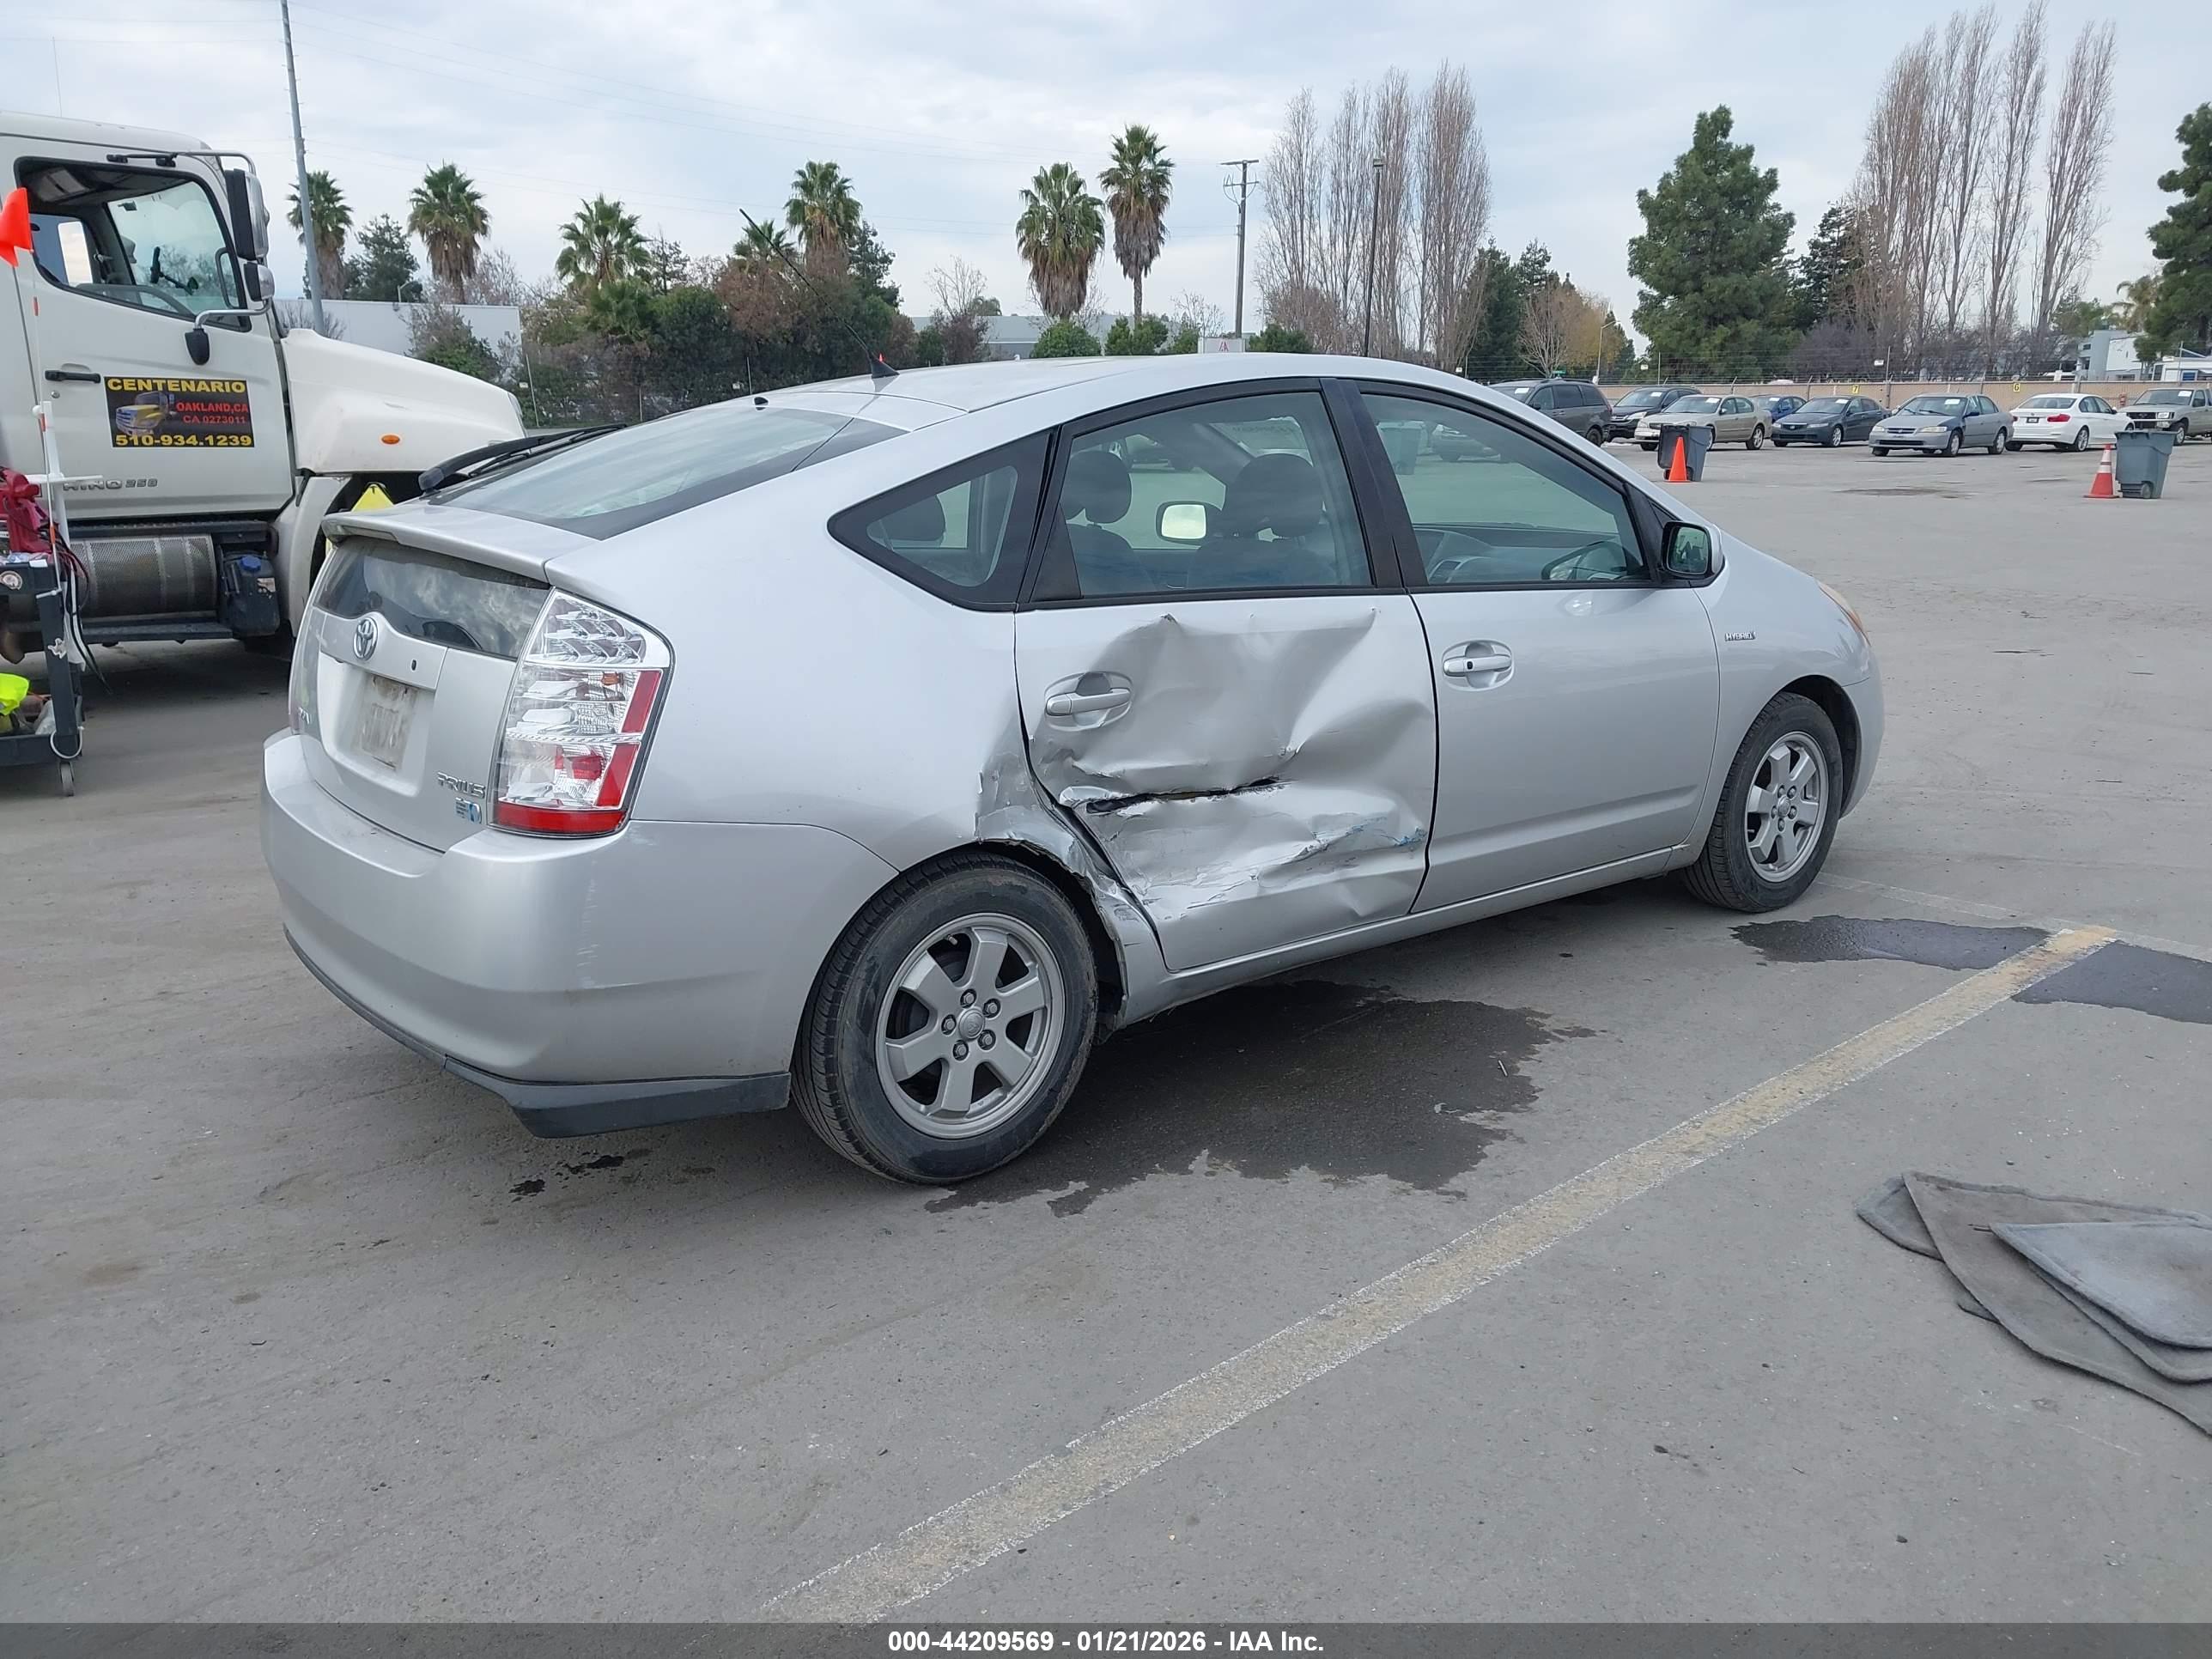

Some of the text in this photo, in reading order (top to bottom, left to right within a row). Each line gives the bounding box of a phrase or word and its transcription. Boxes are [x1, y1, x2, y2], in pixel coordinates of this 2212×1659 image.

[107, 379, 246, 393] CENTENARIO
[176, 402, 248, 413] OAKLAND,CA
[183, 415, 199, 424] CA
[115, 434, 252, 447] 510-934.1239
[437, 771, 485, 799] PRIUS
